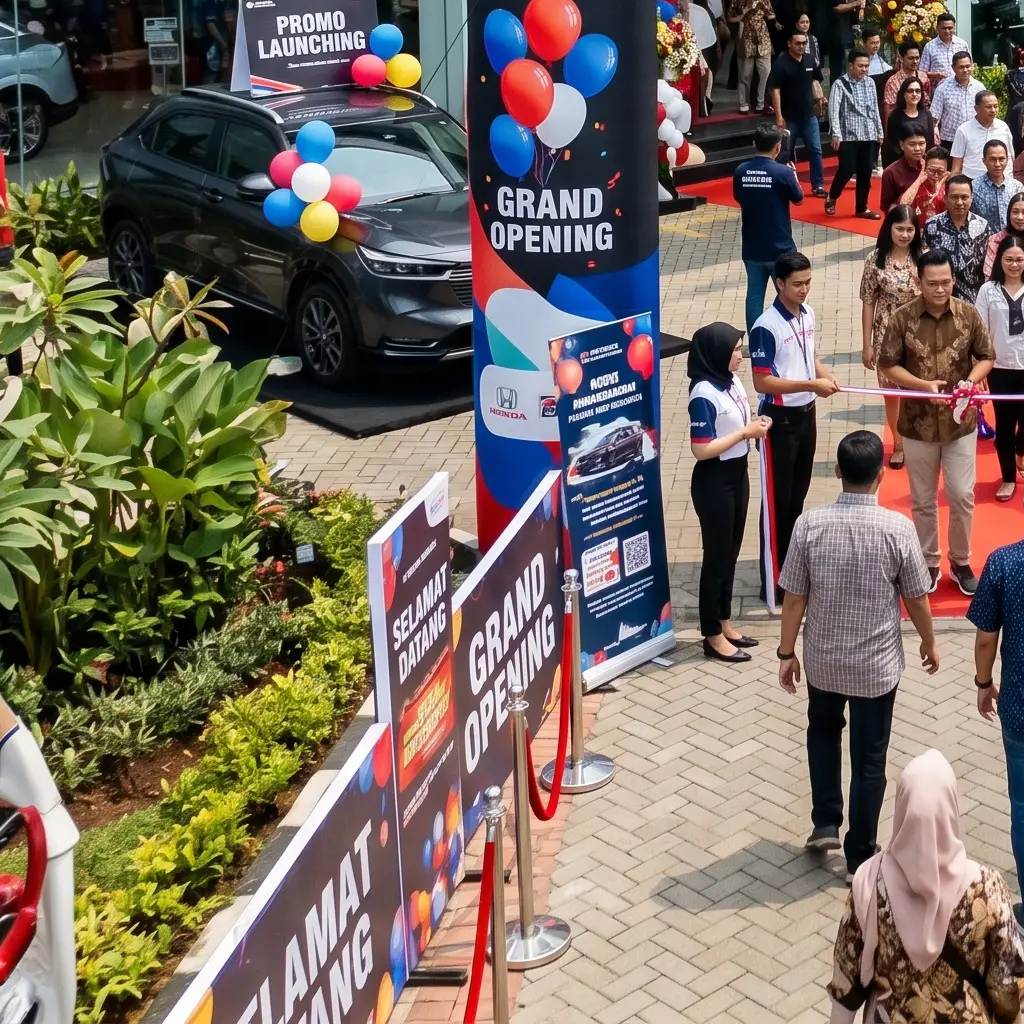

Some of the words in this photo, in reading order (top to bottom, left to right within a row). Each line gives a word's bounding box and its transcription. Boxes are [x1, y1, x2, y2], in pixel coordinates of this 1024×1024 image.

[276, 10, 346, 36] PROMO
[257, 30, 366, 60] LAUNCHING
[497, 185, 604, 221] GRAND
[490, 221, 613, 254] OPENING
[489, 407, 528, 421] HONDA
[392, 561, 448, 651] SELAMAT
[469, 552, 545, 696] GRAND
[398, 601, 446, 685] DATANG
